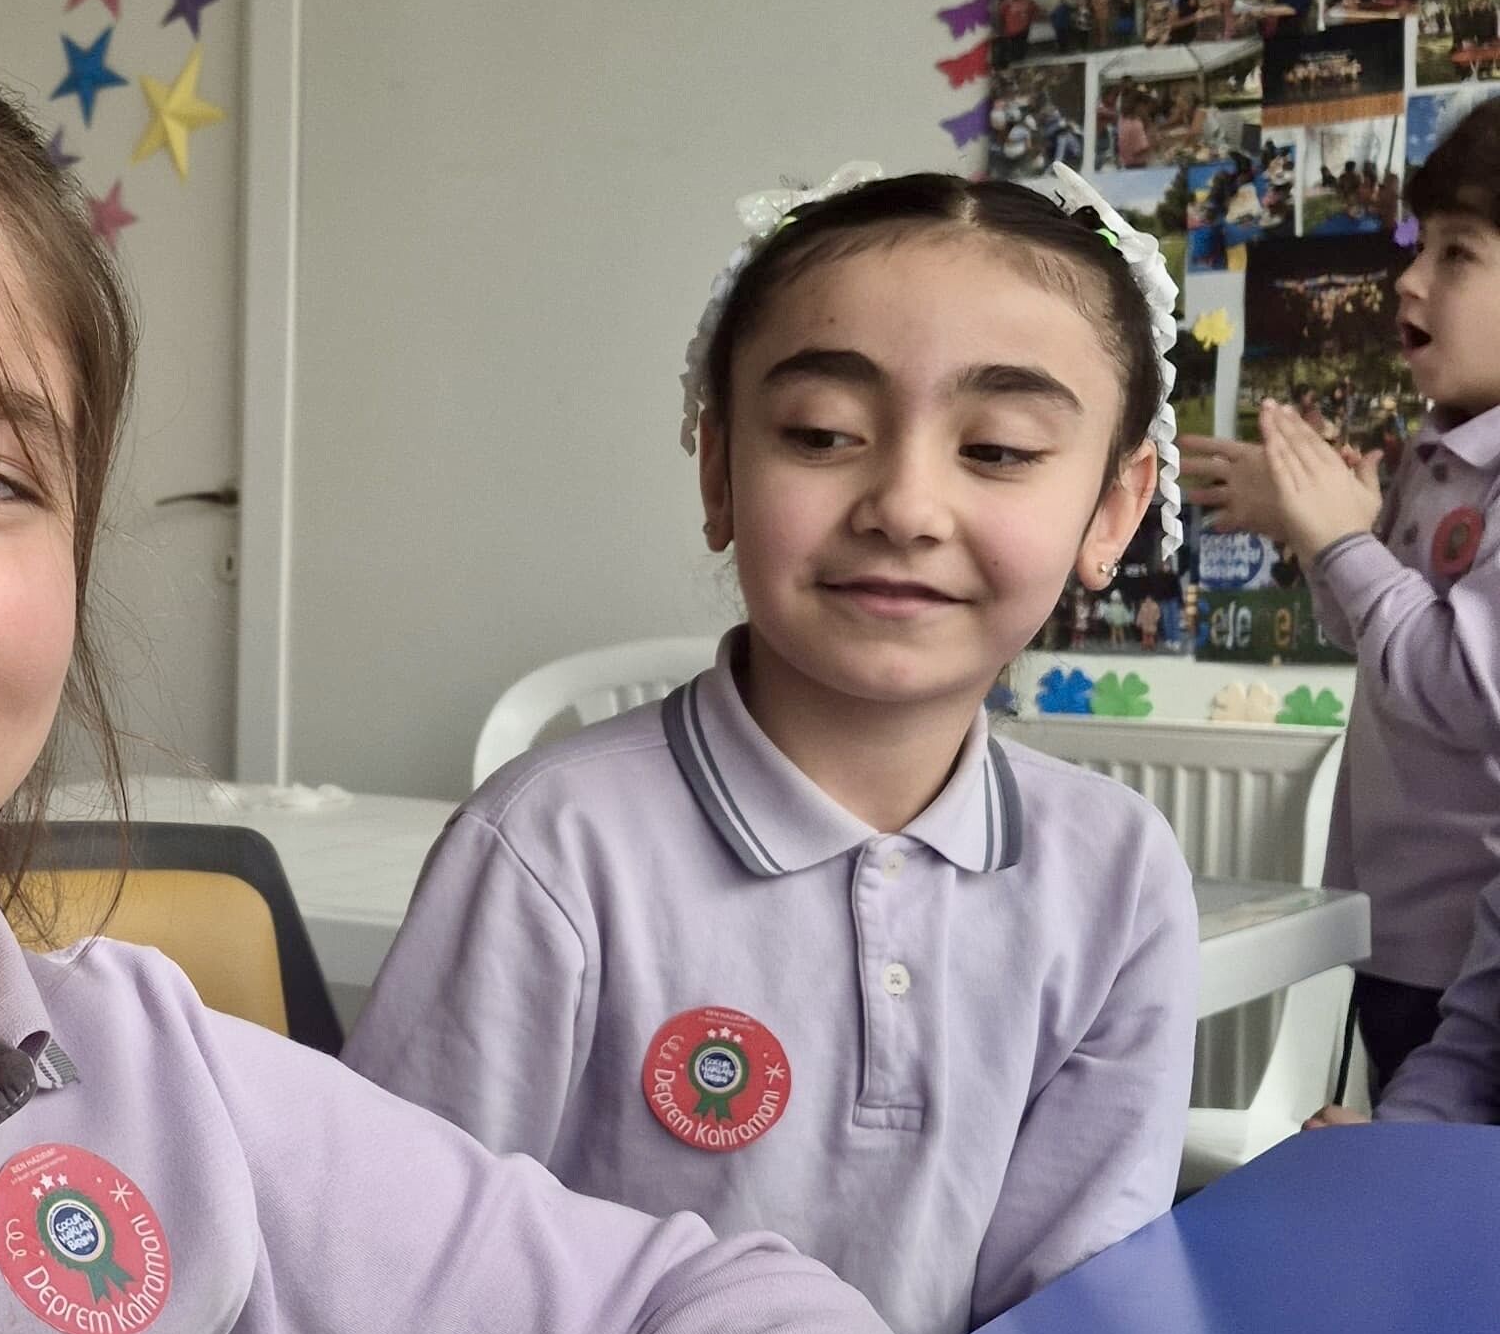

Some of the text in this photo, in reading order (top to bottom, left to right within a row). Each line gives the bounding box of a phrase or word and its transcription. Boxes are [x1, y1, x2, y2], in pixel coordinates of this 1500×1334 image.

[651, 1068, 694, 1136] Deprem
[23, 1213, 166, 1334] Deprem Kahramanı
